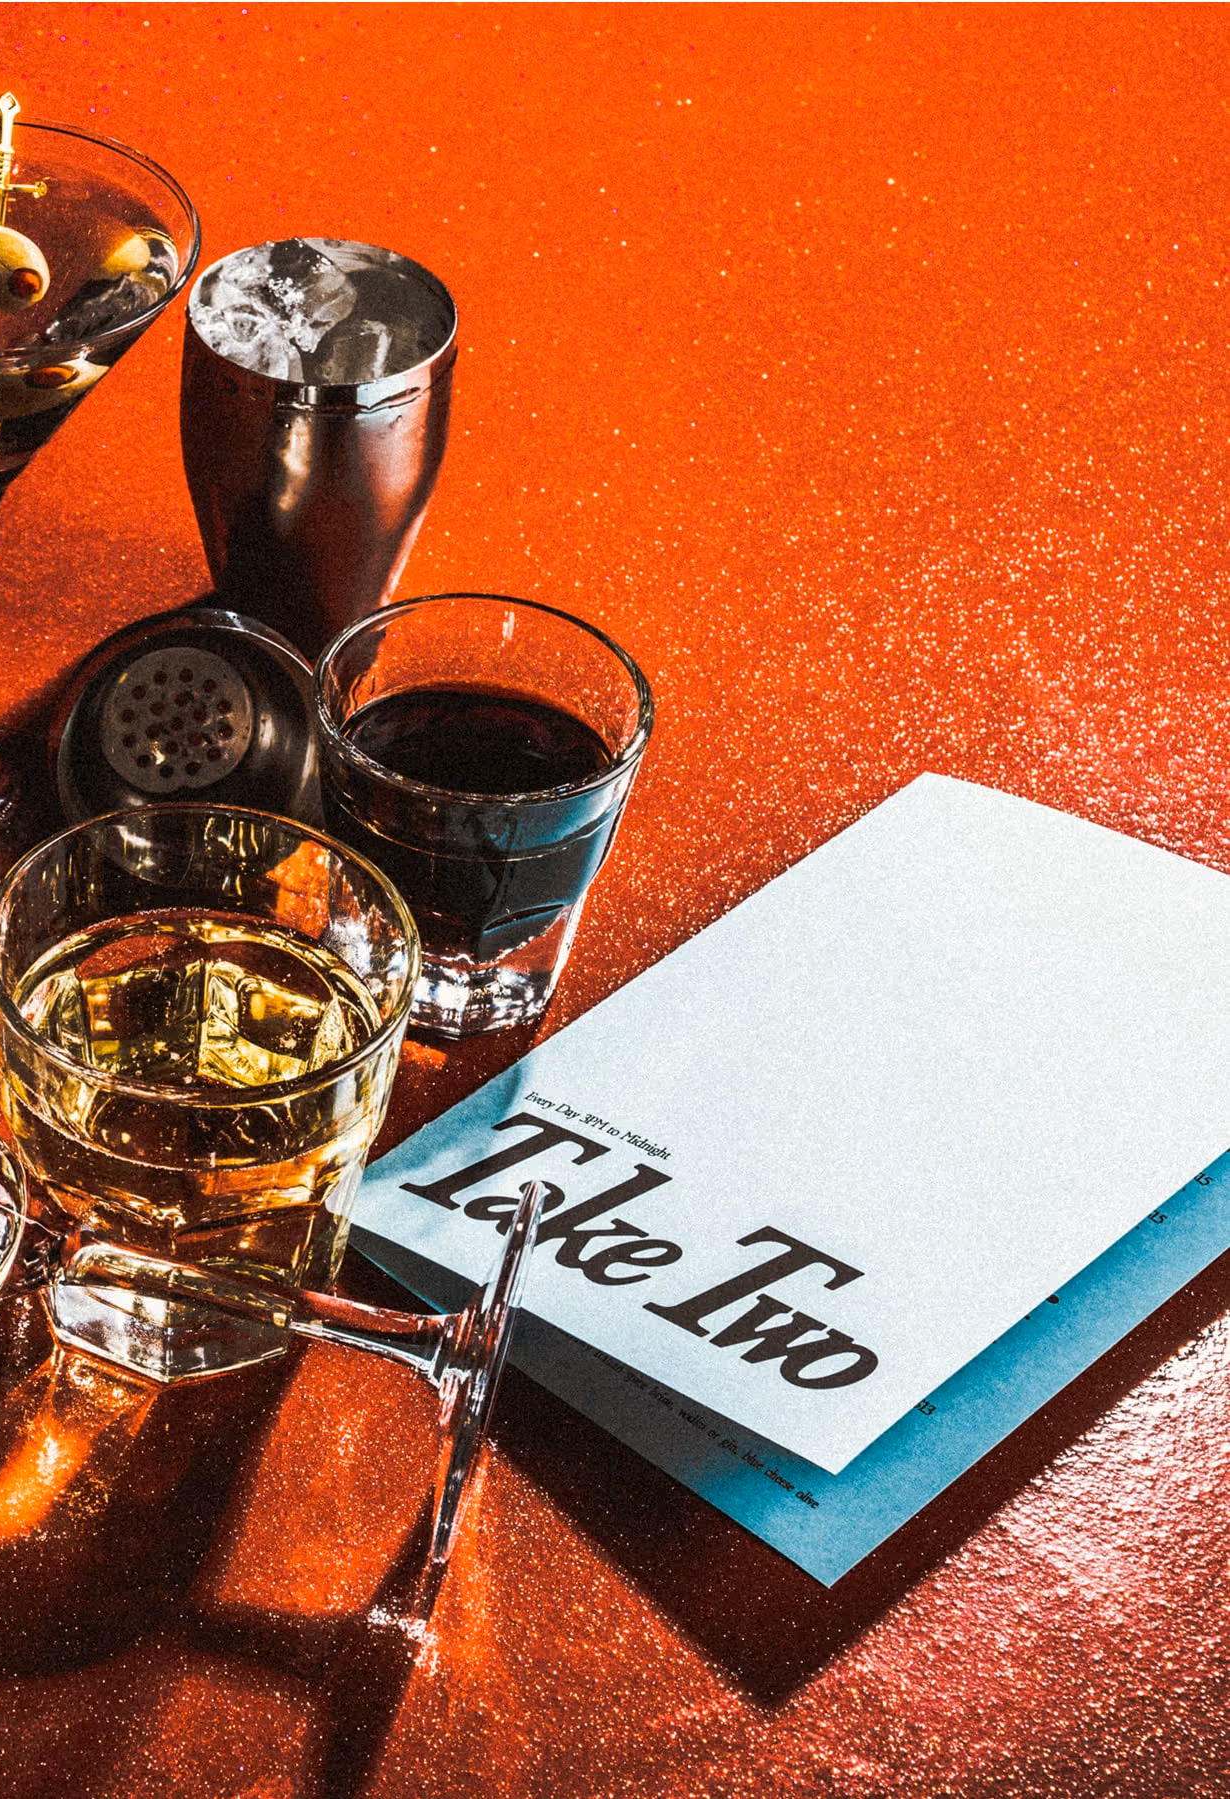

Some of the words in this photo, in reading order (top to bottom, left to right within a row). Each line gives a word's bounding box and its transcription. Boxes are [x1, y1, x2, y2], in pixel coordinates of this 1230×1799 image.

[524, 1091, 555, 1110] Every
[555, 1103, 581, 1120] Day
[579, 1113, 609, 1131] 3PM
[607, 1124, 620, 1136] to
[620, 1131, 671, 1160] Midnight
[399, 1112, 682, 1285] Take
[642, 1225, 880, 1390] Two
[678, 1408, 707, 1430] vodka
[707, 1430, 720, 1440] or
[742, 1451, 764, 1471] blue
[764, 1468, 795, 1491] cheese
[795, 1490, 819, 1509] olive
